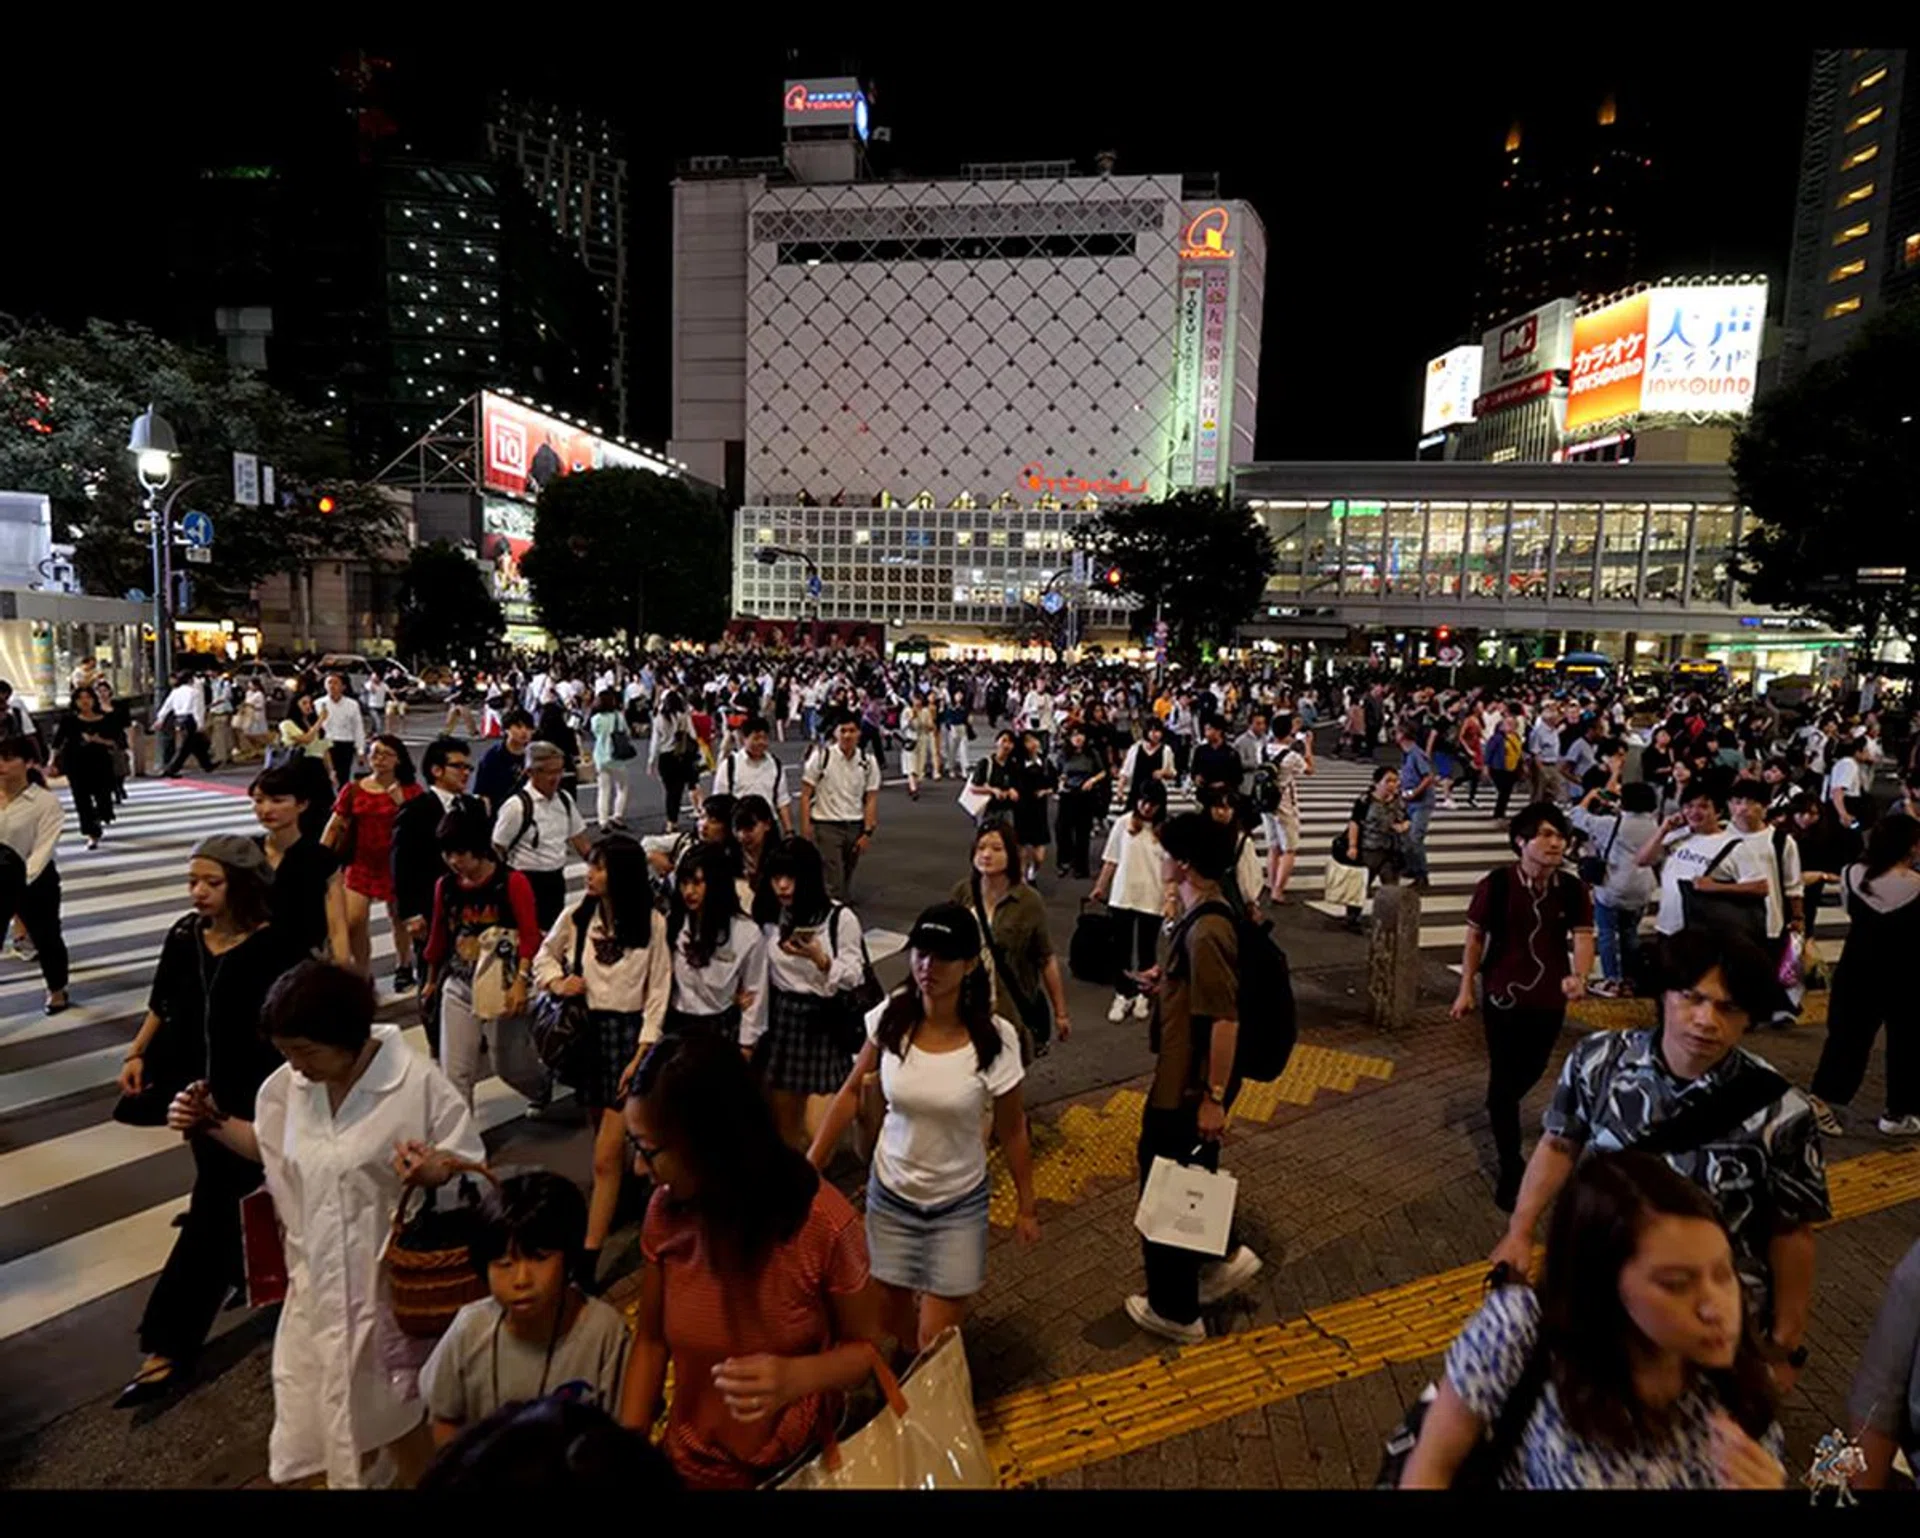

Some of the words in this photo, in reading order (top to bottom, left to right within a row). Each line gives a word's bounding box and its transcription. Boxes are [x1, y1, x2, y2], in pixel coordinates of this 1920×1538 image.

[1574, 333, 1645, 376] カラオケ
[1648, 376, 1750, 395] JOYSOUND
[1042, 477, 1148, 492] TOKYU
